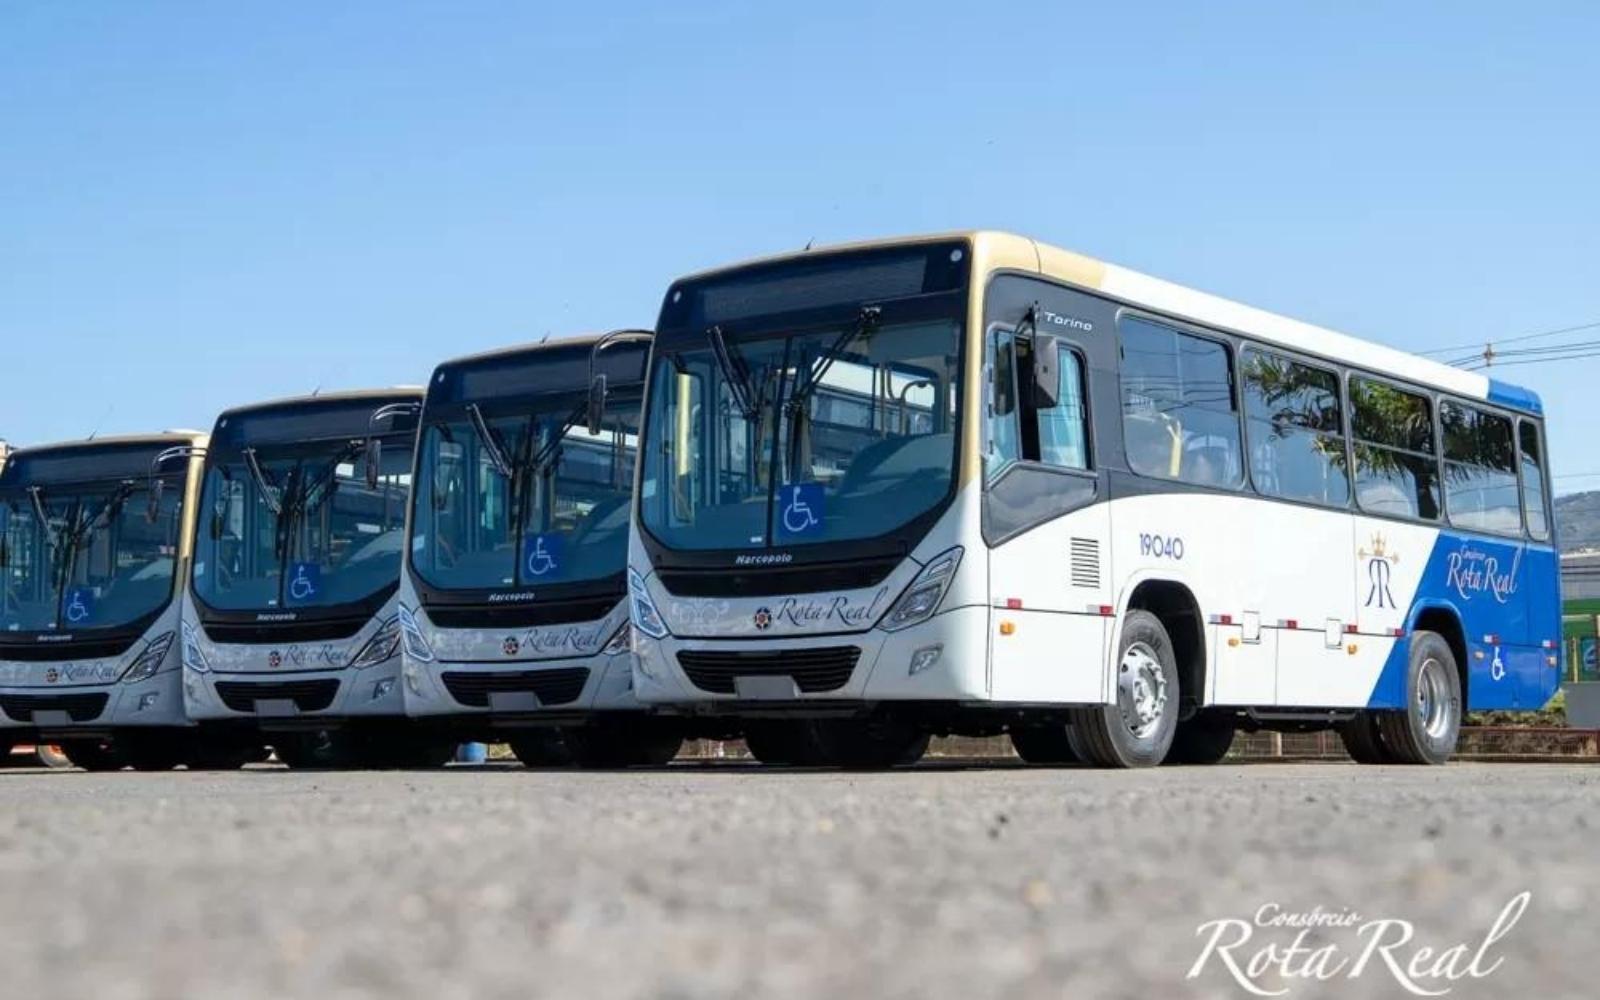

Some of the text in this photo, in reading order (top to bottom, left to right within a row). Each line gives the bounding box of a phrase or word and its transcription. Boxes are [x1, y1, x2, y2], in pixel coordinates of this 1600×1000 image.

[1045, 311, 1092, 331] Torino
[735, 553, 793, 566] Marcopolo
[1140, 533, 1184, 560] 19040
[1446, 552, 1482, 600] Rota
[1483, 545, 1522, 604] Real
[777, 584, 889, 627] Rota Real
[522, 617, 612, 653] Rota Real
